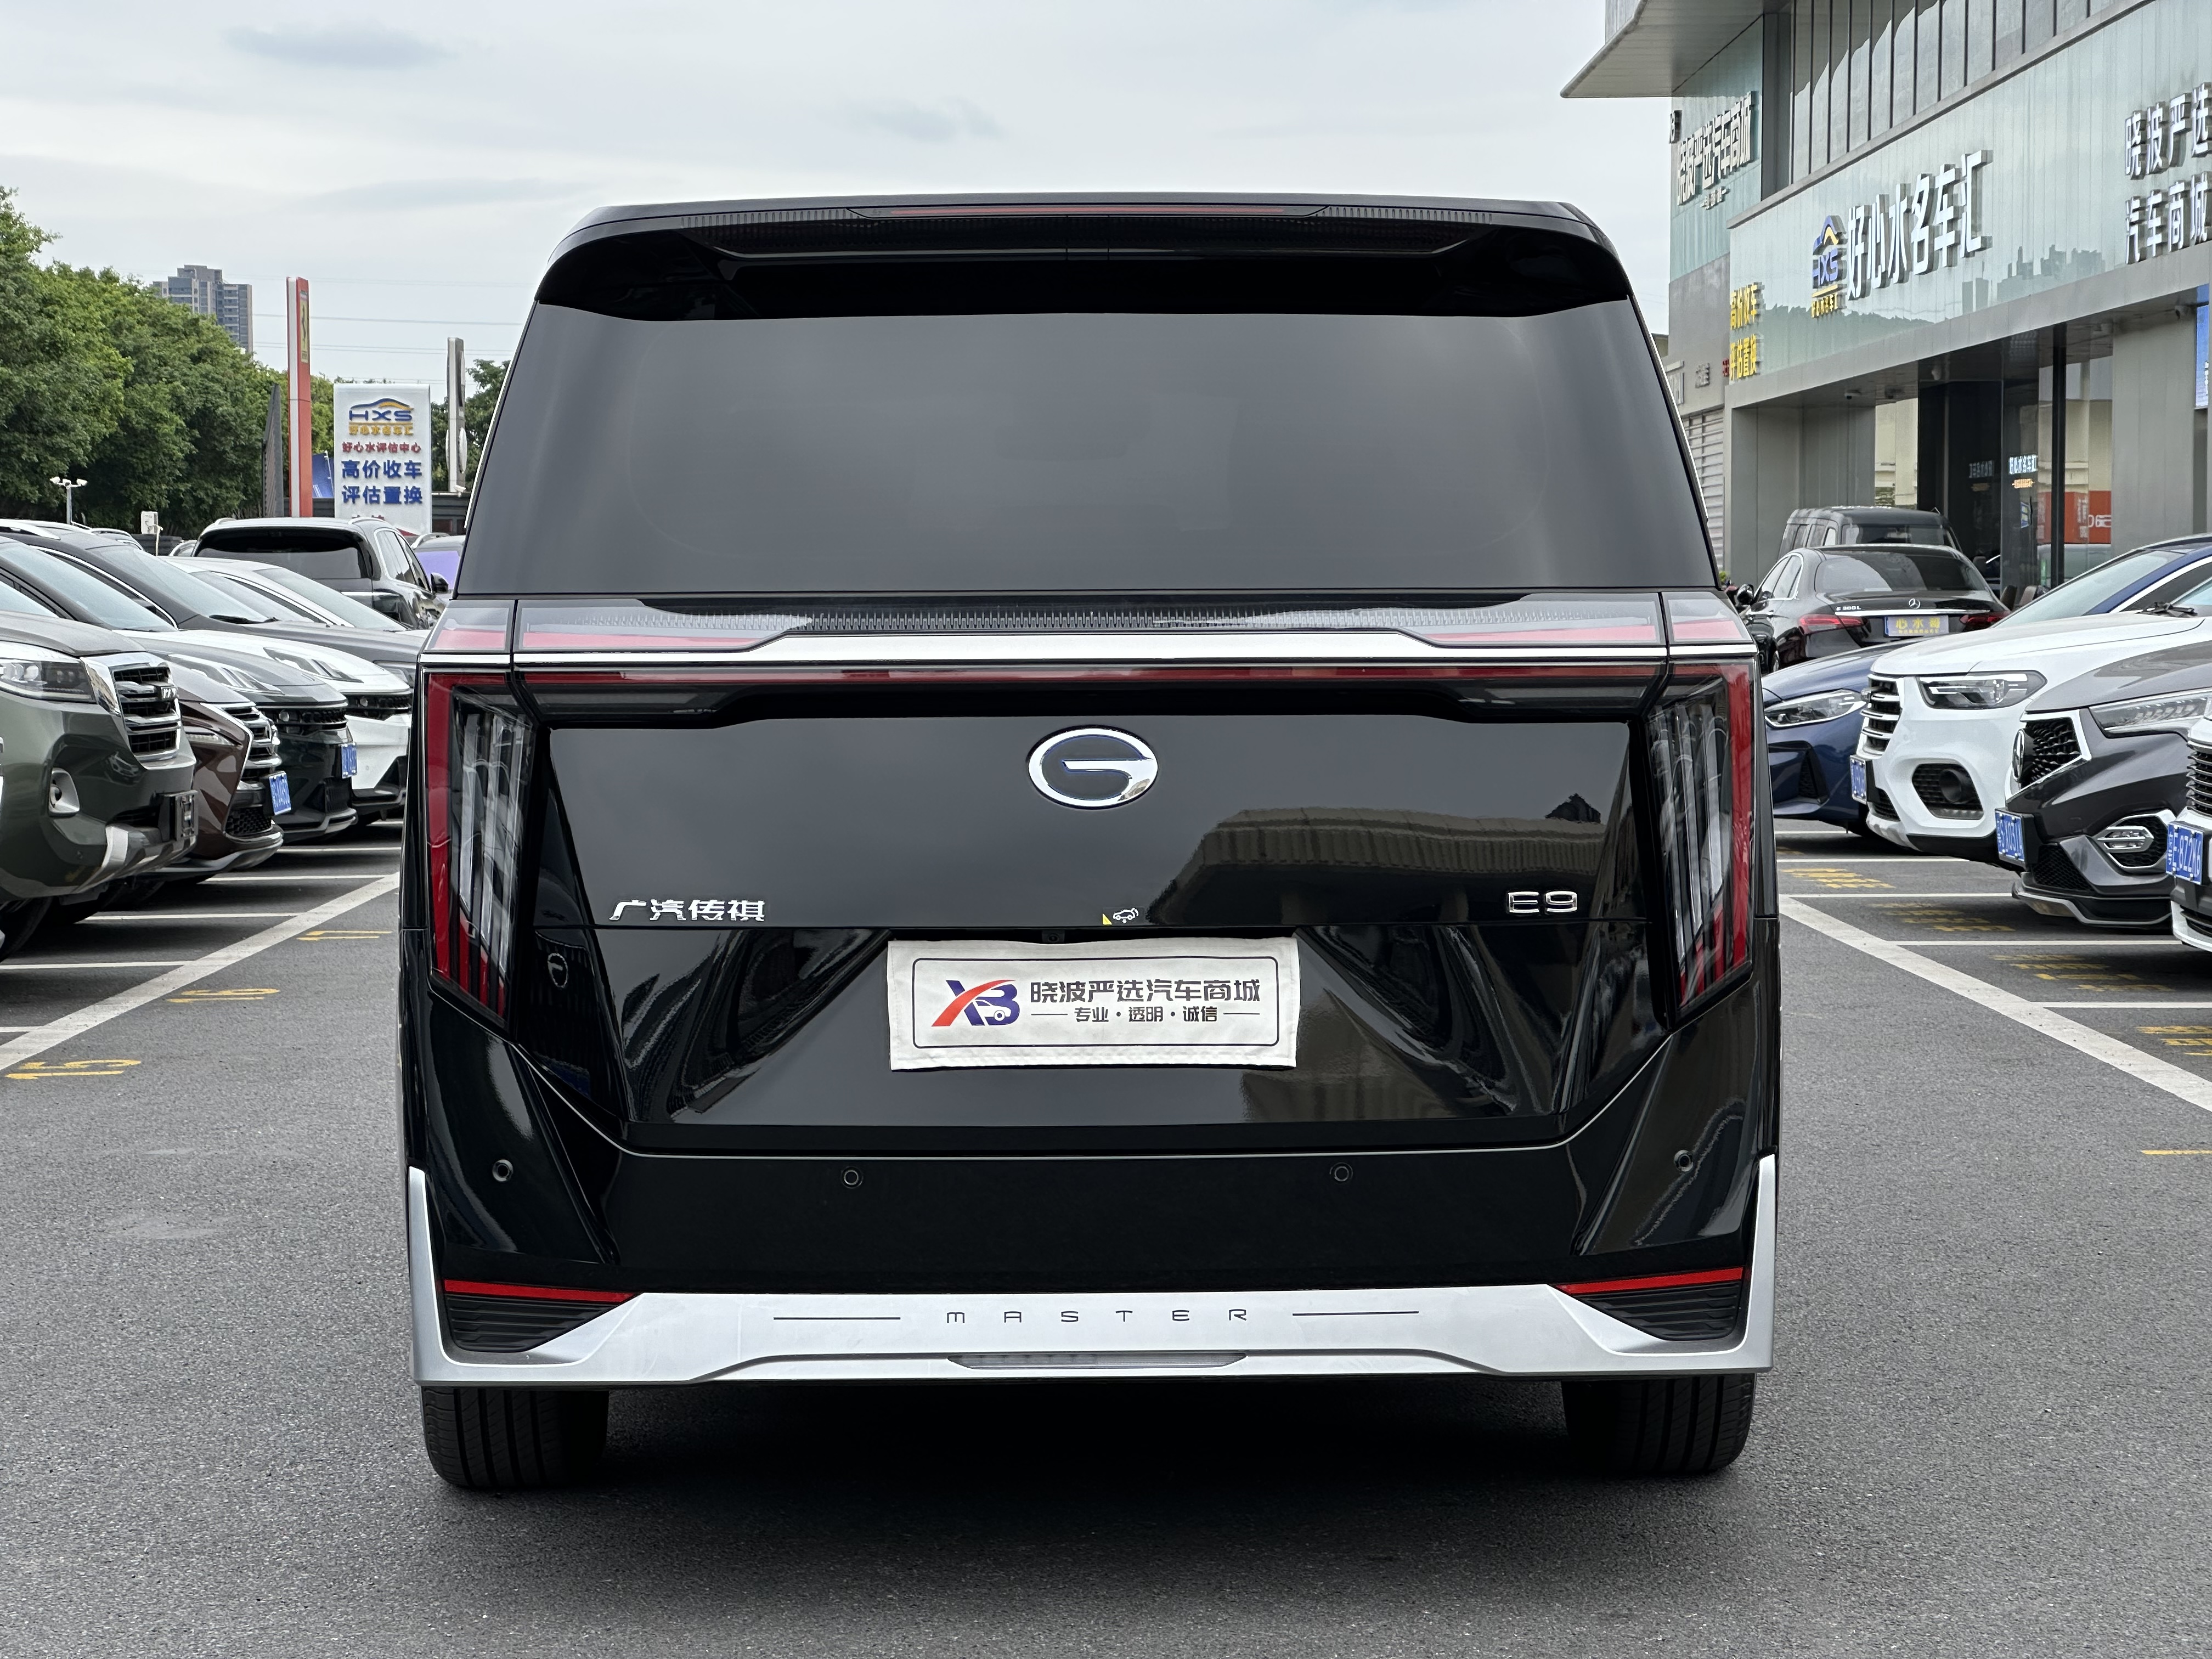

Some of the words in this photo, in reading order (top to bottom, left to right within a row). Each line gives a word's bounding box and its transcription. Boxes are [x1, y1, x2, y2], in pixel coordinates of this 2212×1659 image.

[2125, 82, 2209, 177] 晓波严选
[1677, 91, 1752, 206] 晓波严选汽车商城
[1847, 150, 1985, 301] 好心水名车汇
[2125, 171, 2209, 264] 汽车商城
[349, 410, 412, 421] HXS
[342, 441, 421, 454] 好心水评估中心
[341, 459, 422, 479] 高价收车
[341, 485, 423, 505] 评估置换
[609, 899, 765, 922] 广汽传祺
[1508, 890, 1578, 913] E9
[1030, 979, 1260, 1003] 晓波严选汽车商城
